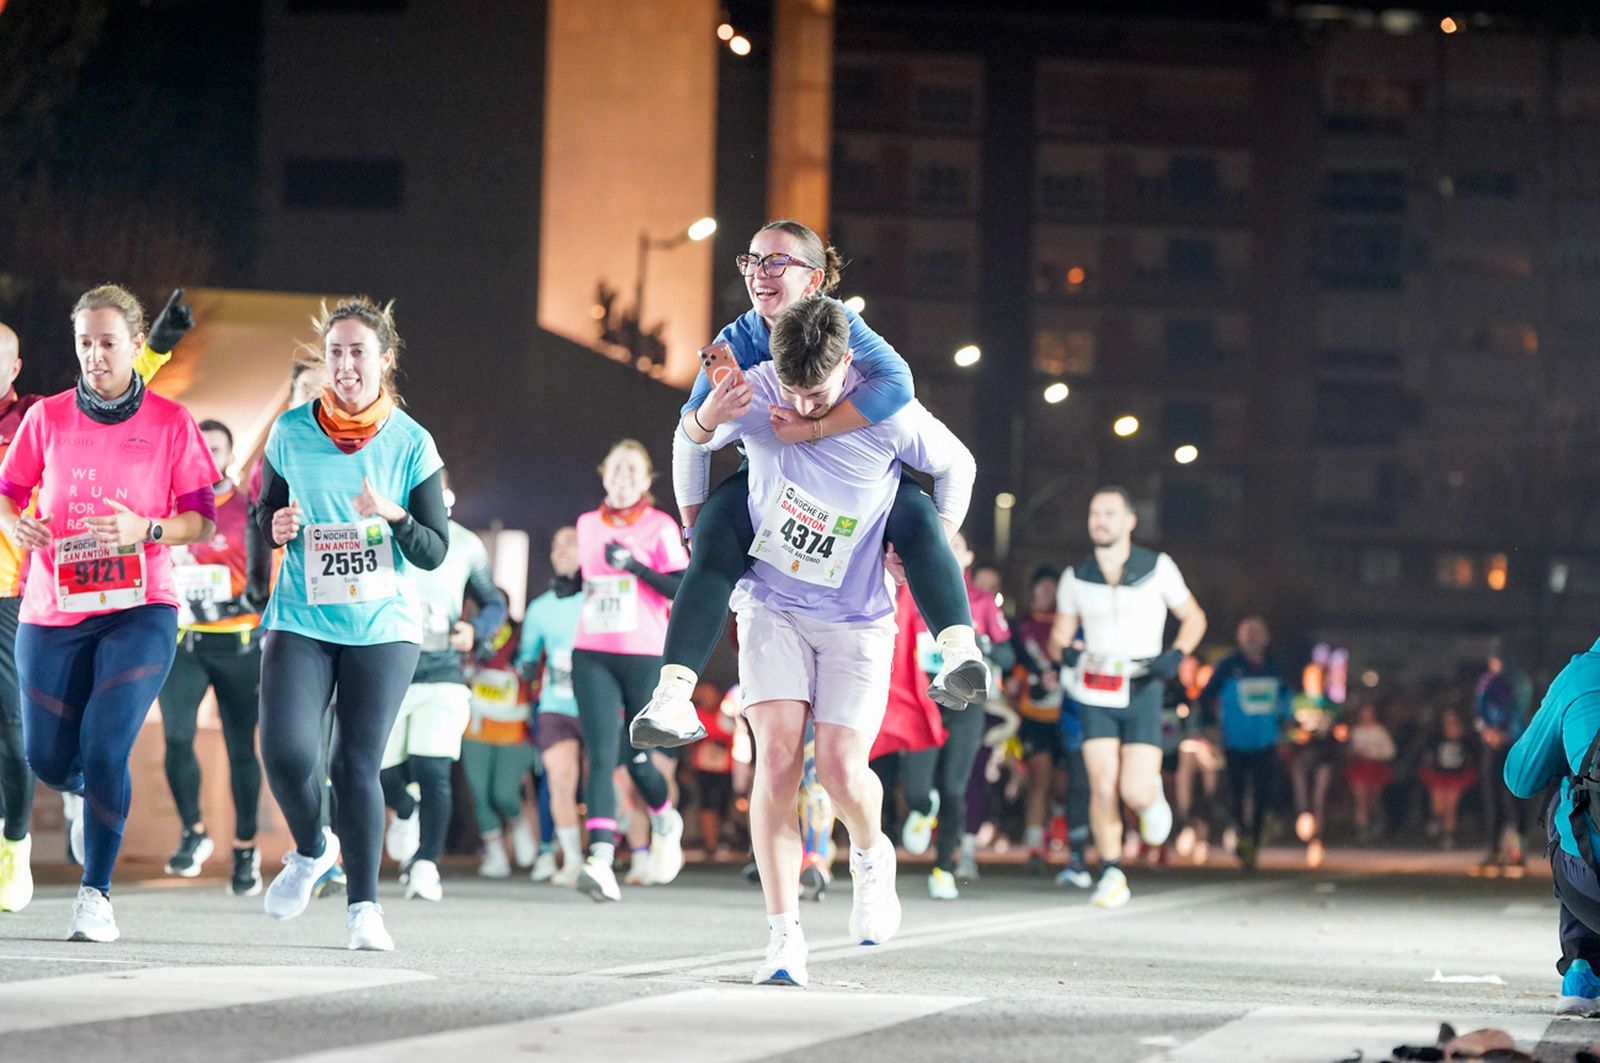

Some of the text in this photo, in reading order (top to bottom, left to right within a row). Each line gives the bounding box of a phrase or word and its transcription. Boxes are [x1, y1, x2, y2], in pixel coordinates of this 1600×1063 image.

[71, 468, 97, 481] WE
[68, 502, 95, 515] FOR
[781, 500, 797, 515] SAN
[794, 497, 817, 517] NOCHE
[817, 512, 829, 522] DE
[323, 532, 348, 540] NOCHE
[350, 531, 359, 540] DE
[780, 517, 836, 559] 4374
[73, 541, 97, 550] NOCHE
[315, 542, 330, 552] SAN
[64, 552, 80, 562] SAN
[321, 549, 378, 576] 2553
[795, 551, 821, 564] ANTONIO
